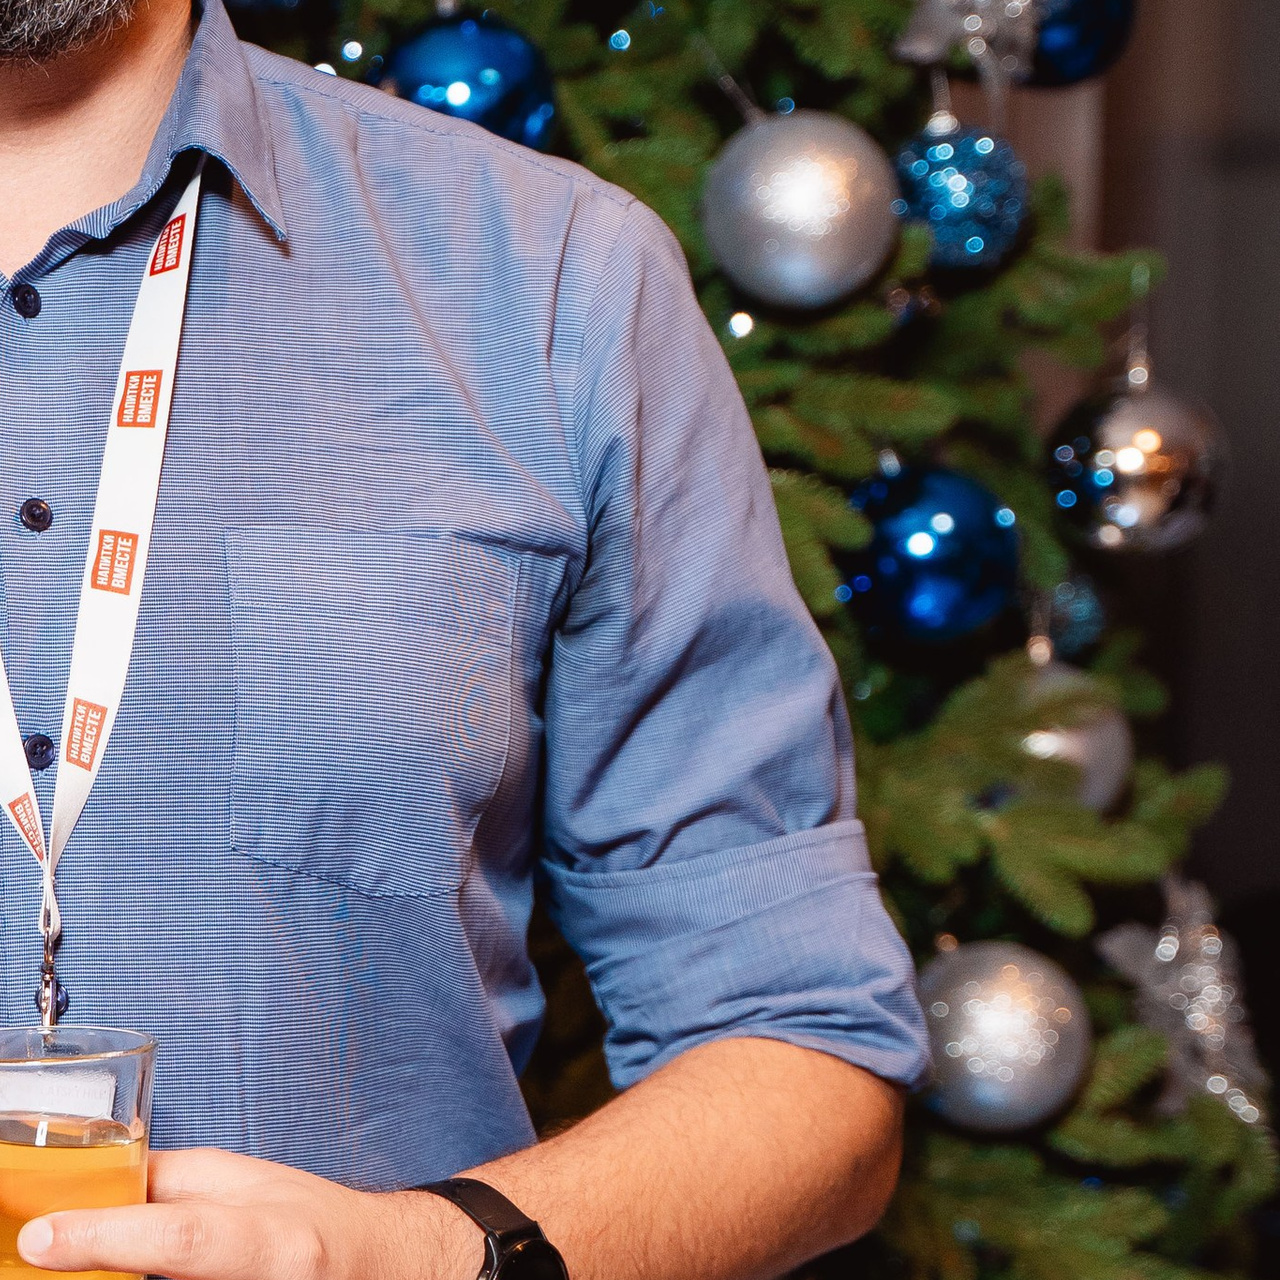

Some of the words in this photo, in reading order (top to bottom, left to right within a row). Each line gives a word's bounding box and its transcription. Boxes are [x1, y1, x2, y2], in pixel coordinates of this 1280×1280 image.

[165, 219, 182, 268] ВМЕСТЕ
[123, 376, 140, 423] НАПИТКИ
[138, 374, 157, 423] ВМЕСТЕ
[96, 534, 115, 585] НАПИТКИ
[113, 536, 133, 588] ВМЕСТЕ
[70, 704, 87, 759] НАПИТКИ
[80, 709, 102, 764] ВМЕСТЕ
